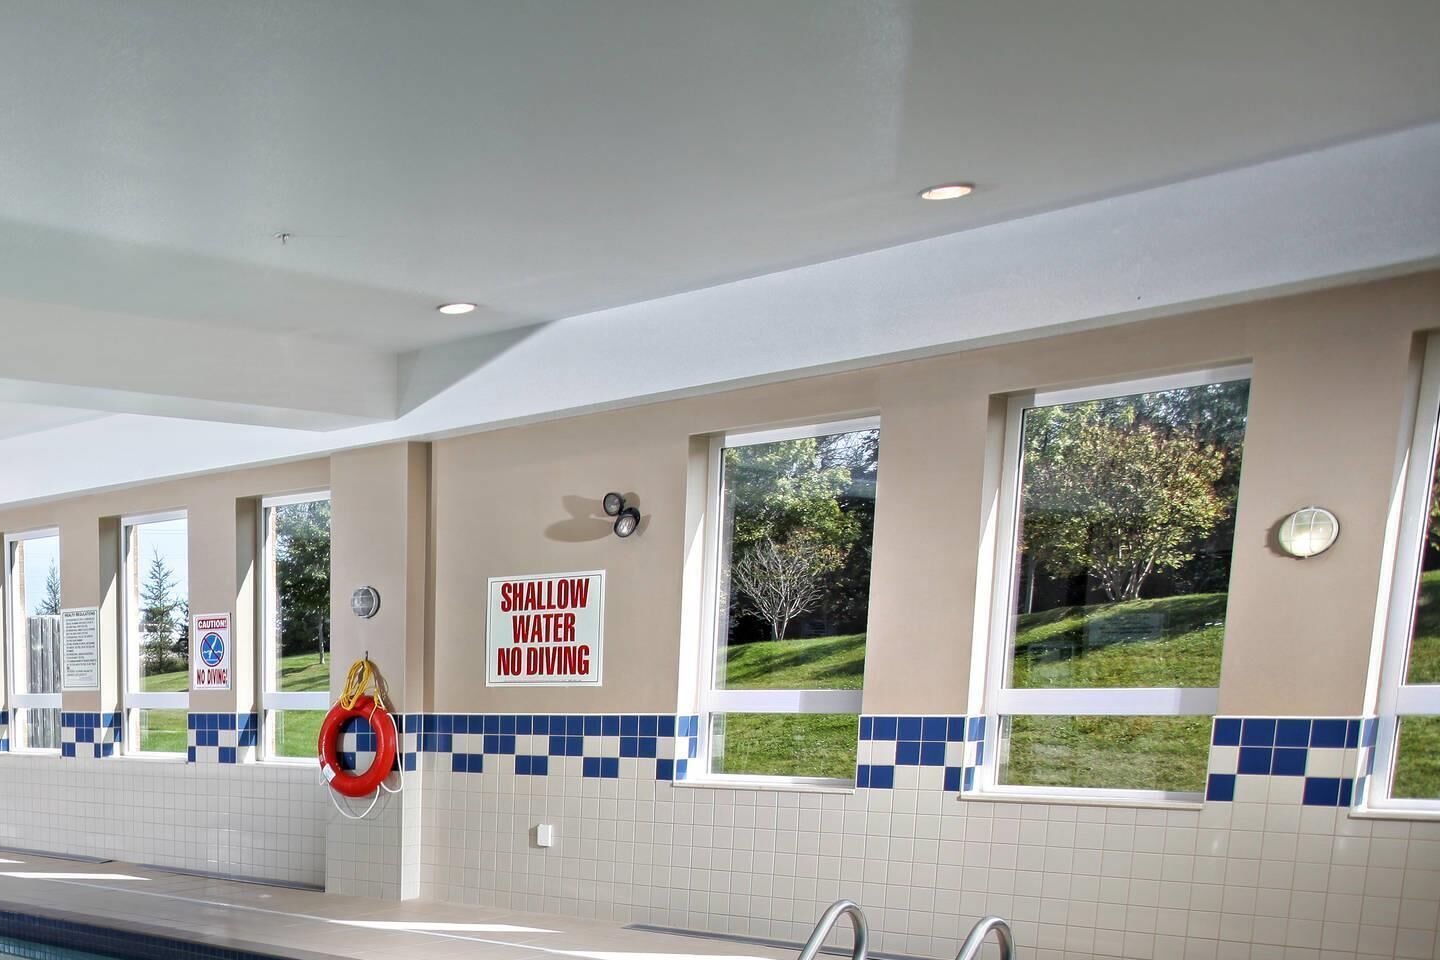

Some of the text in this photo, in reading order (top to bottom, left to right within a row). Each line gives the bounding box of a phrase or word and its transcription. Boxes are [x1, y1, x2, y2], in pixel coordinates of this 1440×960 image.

[501, 578, 589, 612] SHALLOW
[198, 619, 227, 628] CAUTION!
[512, 613, 575, 643] WATER
[497, 645, 590, 676] NO DIVING
[197, 669, 228, 684] NO DIVING!
